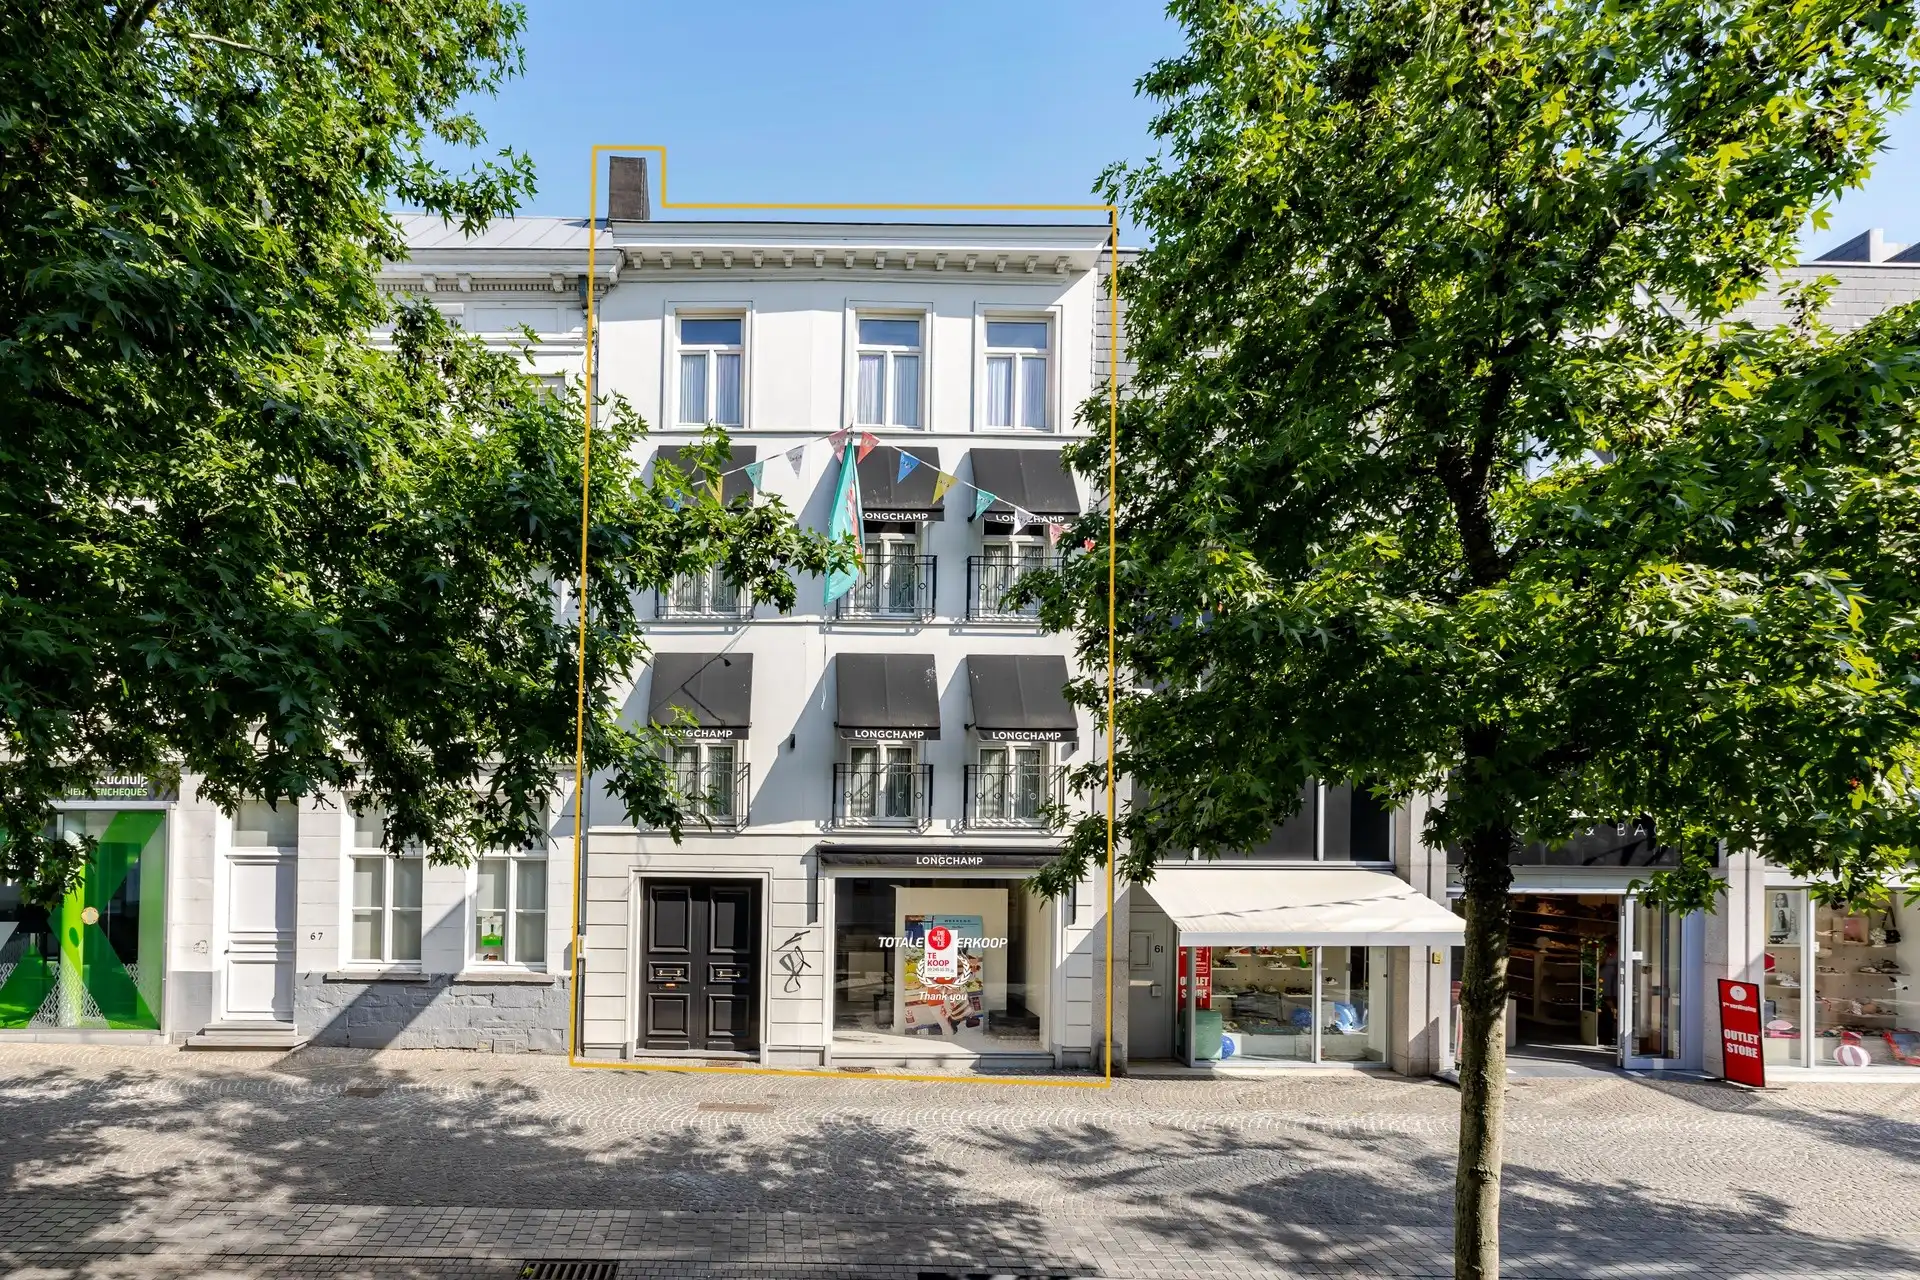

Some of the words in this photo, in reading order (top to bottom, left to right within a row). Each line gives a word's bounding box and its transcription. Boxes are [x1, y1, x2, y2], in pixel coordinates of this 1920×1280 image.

[862, 512, 928, 520] ONGCHAMP
[996, 514, 1064, 523] LONHAMP
[855, 730, 924, 739] LONGCHAMP
[992, 731, 1061, 740] LONGCHAMP
[1585, 827, 1595, 836] &
[916, 857, 983, 865] LONGCHAMP
[310, 932, 323, 940] 67
[878, 937, 924, 948] TOTALE
[957, 937, 1008, 949] ERKOOP
[1154, 945, 1163, 953] 61
[1180, 977, 1209, 986] OLET
[919, 991, 947, 1001] Thank
[949, 993, 967, 1003] you
[1181, 989, 1207, 999] SRE
[1724, 1029, 1759, 1045] OUTLET
[1726, 1043, 1758, 1059] STORE
